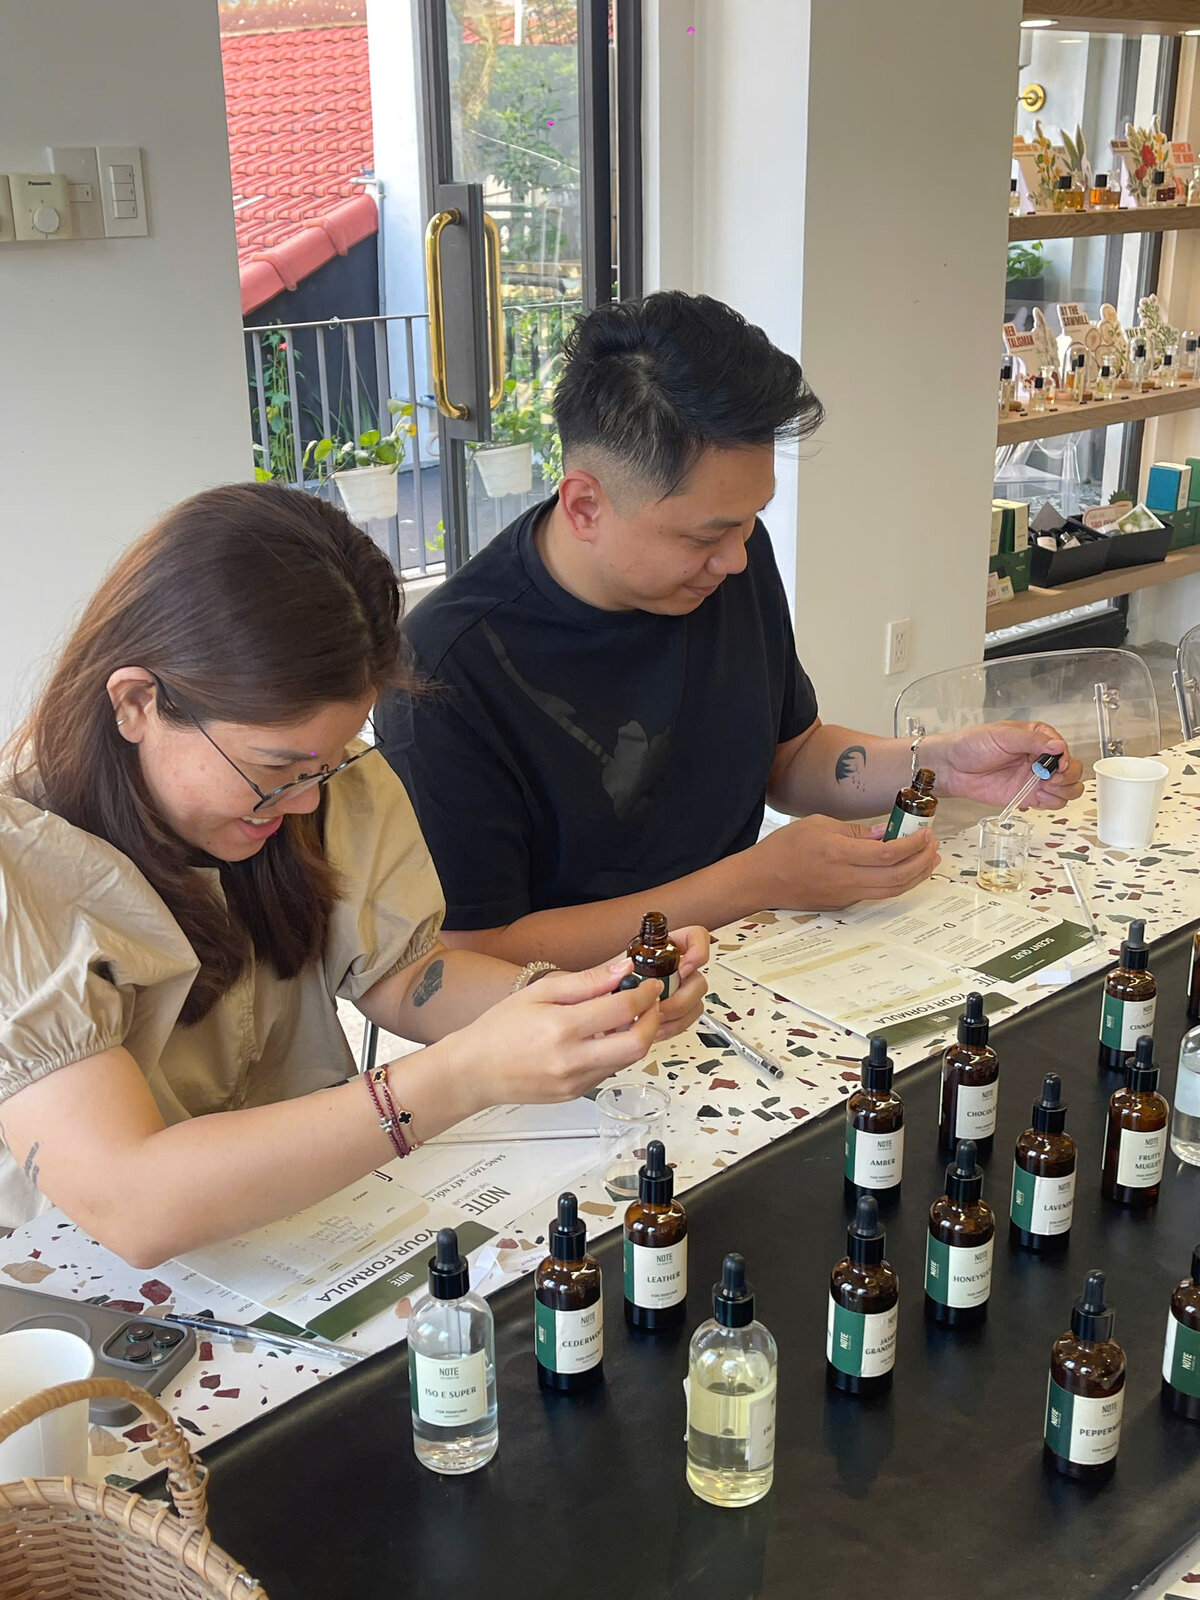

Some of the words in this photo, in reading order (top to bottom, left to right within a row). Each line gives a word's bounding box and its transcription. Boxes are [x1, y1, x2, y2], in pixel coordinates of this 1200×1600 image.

[1062, 315, 1089, 327] SAWMILL
[1006, 334, 1035, 348] TALISMAN
[1031, 937, 1056, 952] SCENT
[1010, 947, 1033, 961] QUIZ
[935, 992, 969, 1008] YOUR
[873, 1004, 936, 1025] FORMULA
[877, 1139, 893, 1148] NOTE
[869, 1158, 896, 1167] AMBER
[392, 1228, 440, 1257] YOUR
[655, 1252, 673, 1263] NOTE
[314, 1255, 397, 1303] FORMULA
[390, 1271, 415, 1288] NOTE
[646, 1270, 681, 1284] LEATHER
[839, 1331, 849, 1350] NOTE
[1182, 1352, 1193, 1371] NOTE
[439, 1367, 460, 1377] NOTE
[424, 1386, 439, 1398] ISO
[441, 1391, 447, 1399] E
[448, 1385, 477, 1399] SUPER
[1101, 1402, 1118, 1414] NOTE
[1050, 1407, 1060, 1428] NOTE
